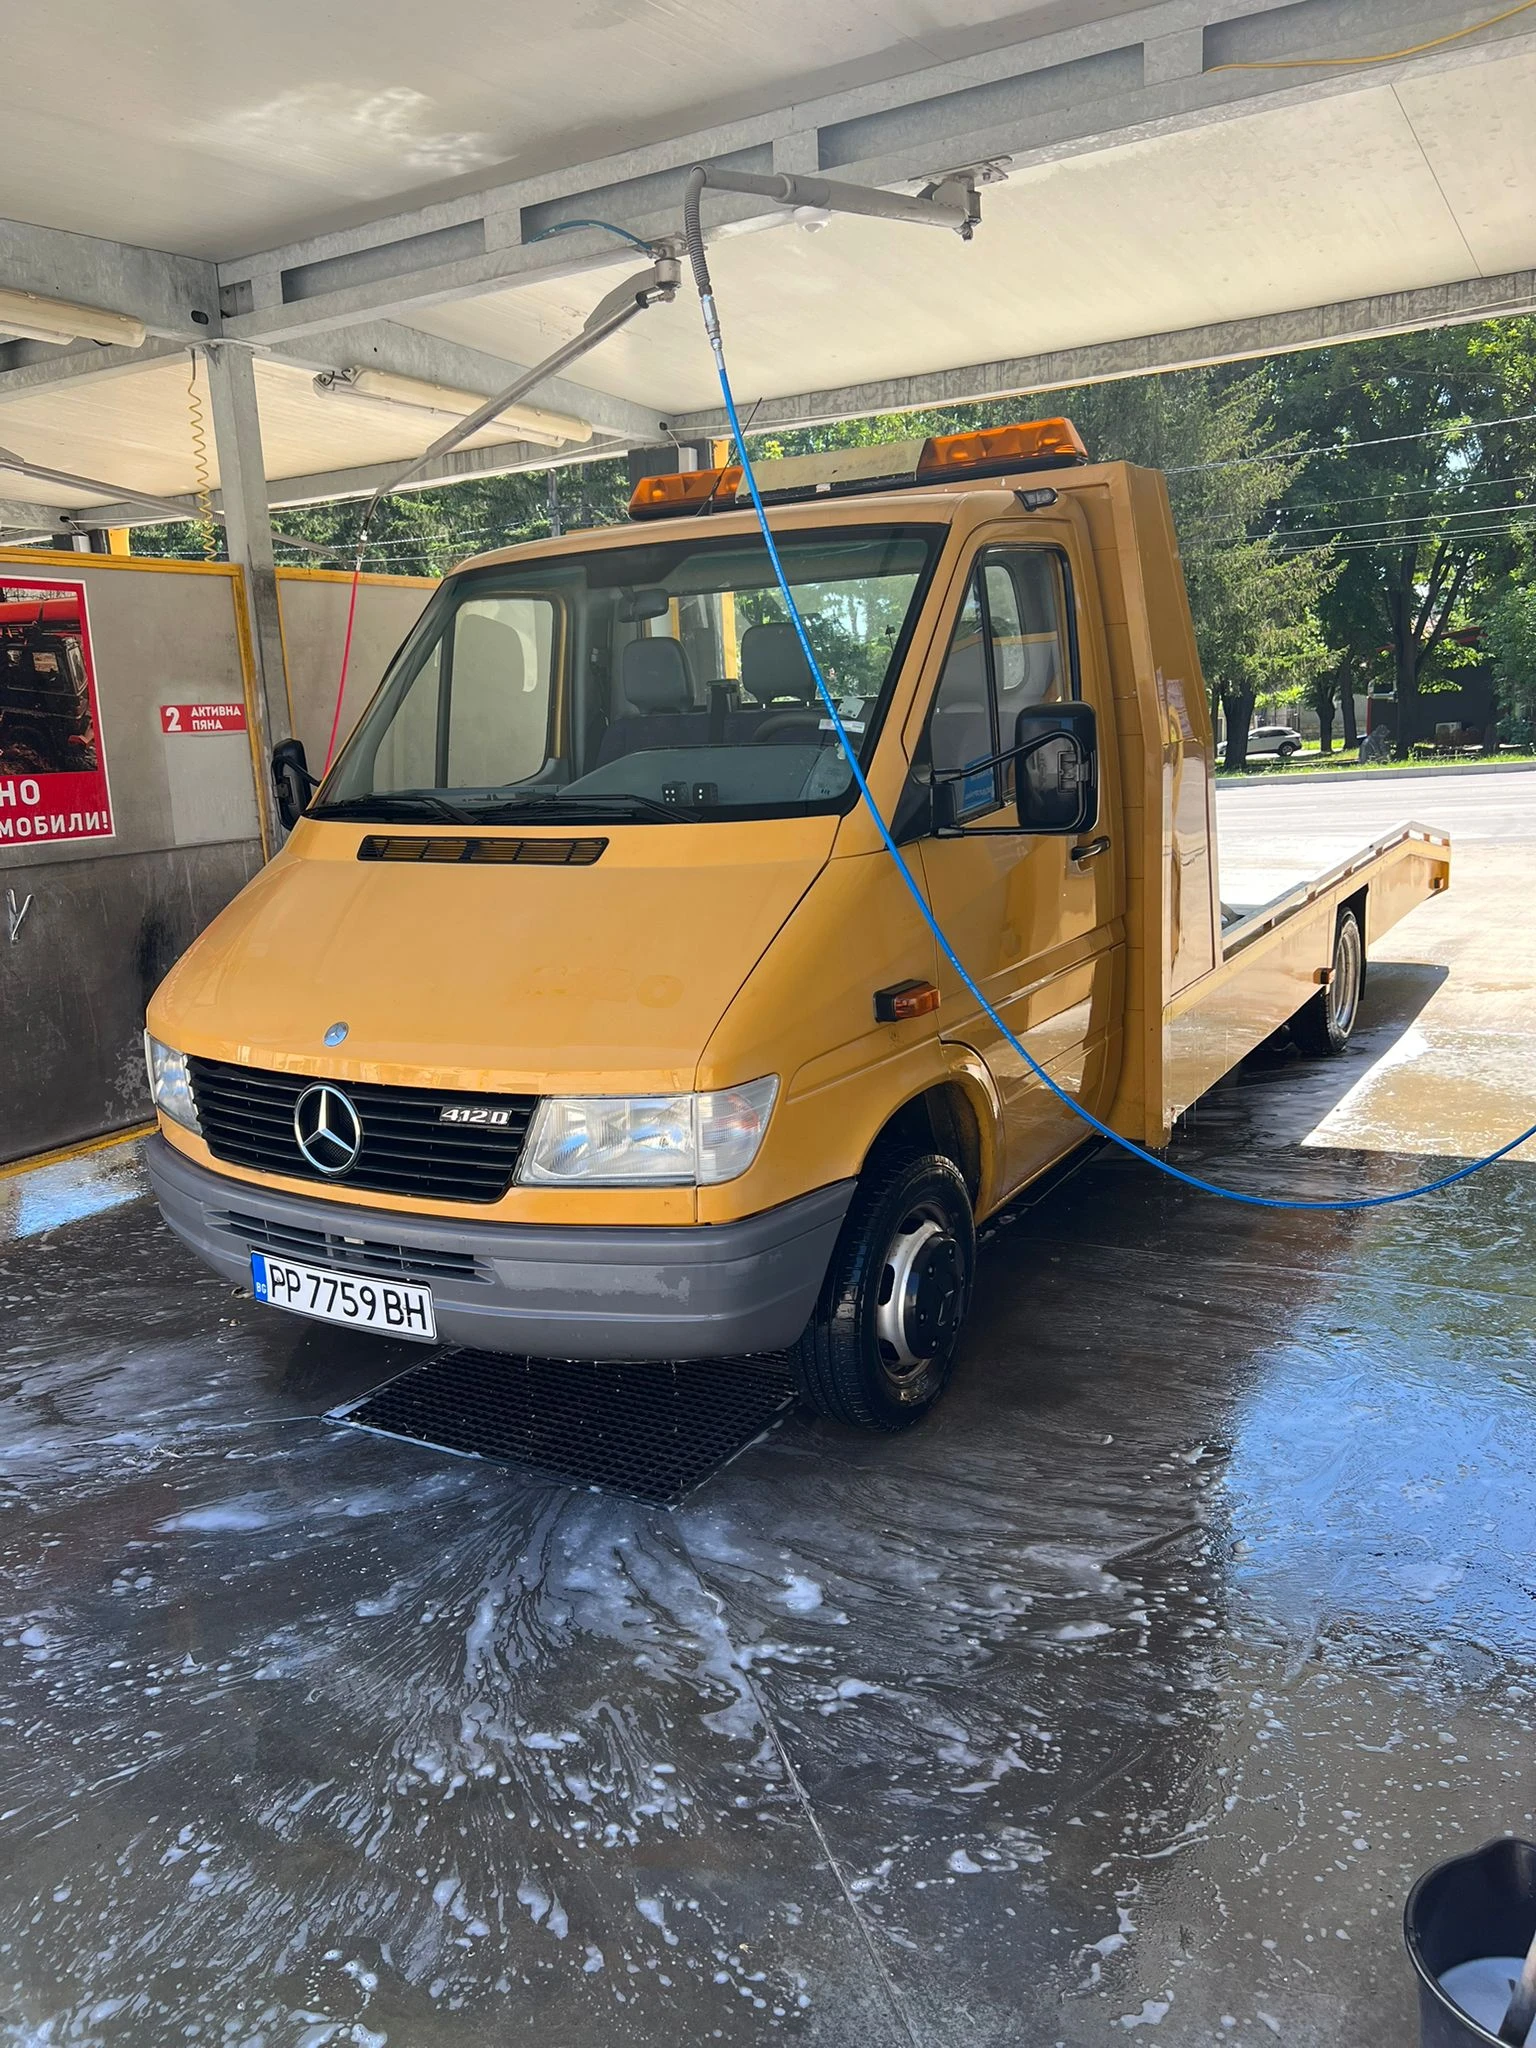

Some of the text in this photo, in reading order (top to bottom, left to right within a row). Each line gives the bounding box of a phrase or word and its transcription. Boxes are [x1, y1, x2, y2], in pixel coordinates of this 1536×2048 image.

[191, 705, 241, 717] АКТИВНА
[165, 707, 182, 732] 2
[192, 719, 223, 731] ПЯНА
[256, 1281, 267, 1295] BG
[306, 1273, 377, 1321] 7759
